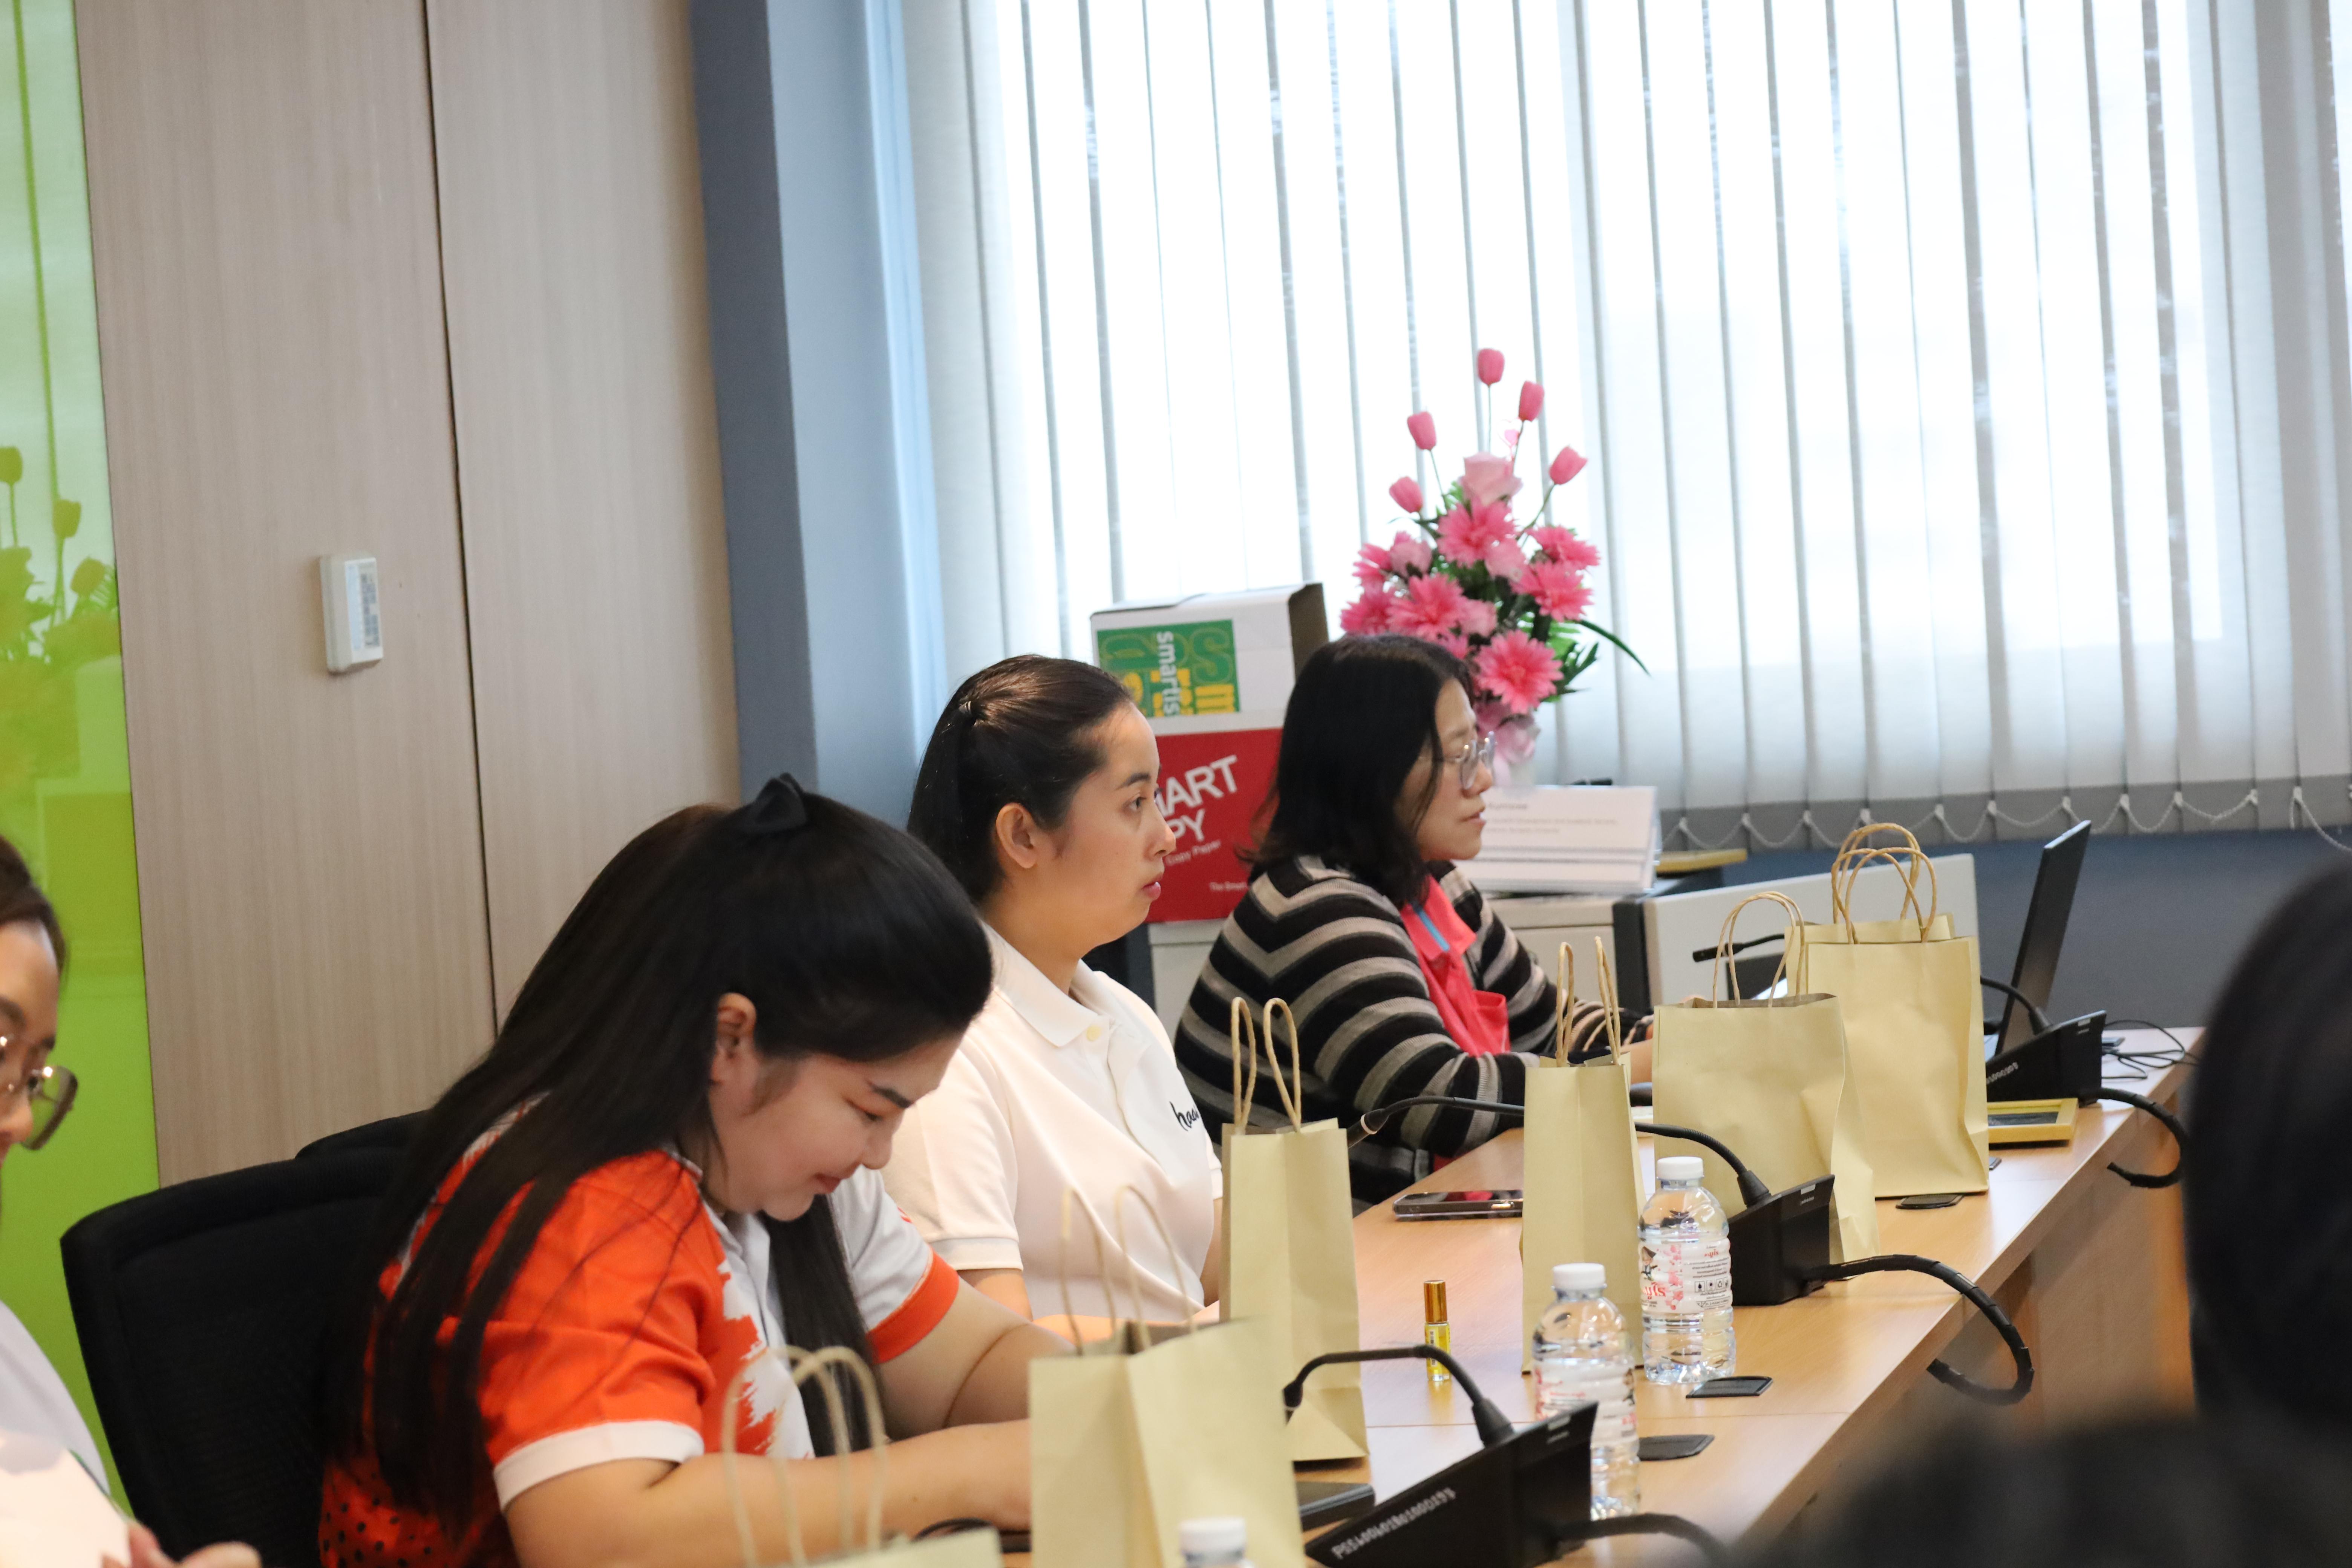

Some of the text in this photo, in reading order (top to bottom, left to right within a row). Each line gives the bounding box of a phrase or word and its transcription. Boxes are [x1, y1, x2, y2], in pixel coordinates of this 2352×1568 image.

[1156, 631, 1181, 716] smartis
[1155, 754, 1238, 818] ART
[1165, 808, 1205, 842] PY
